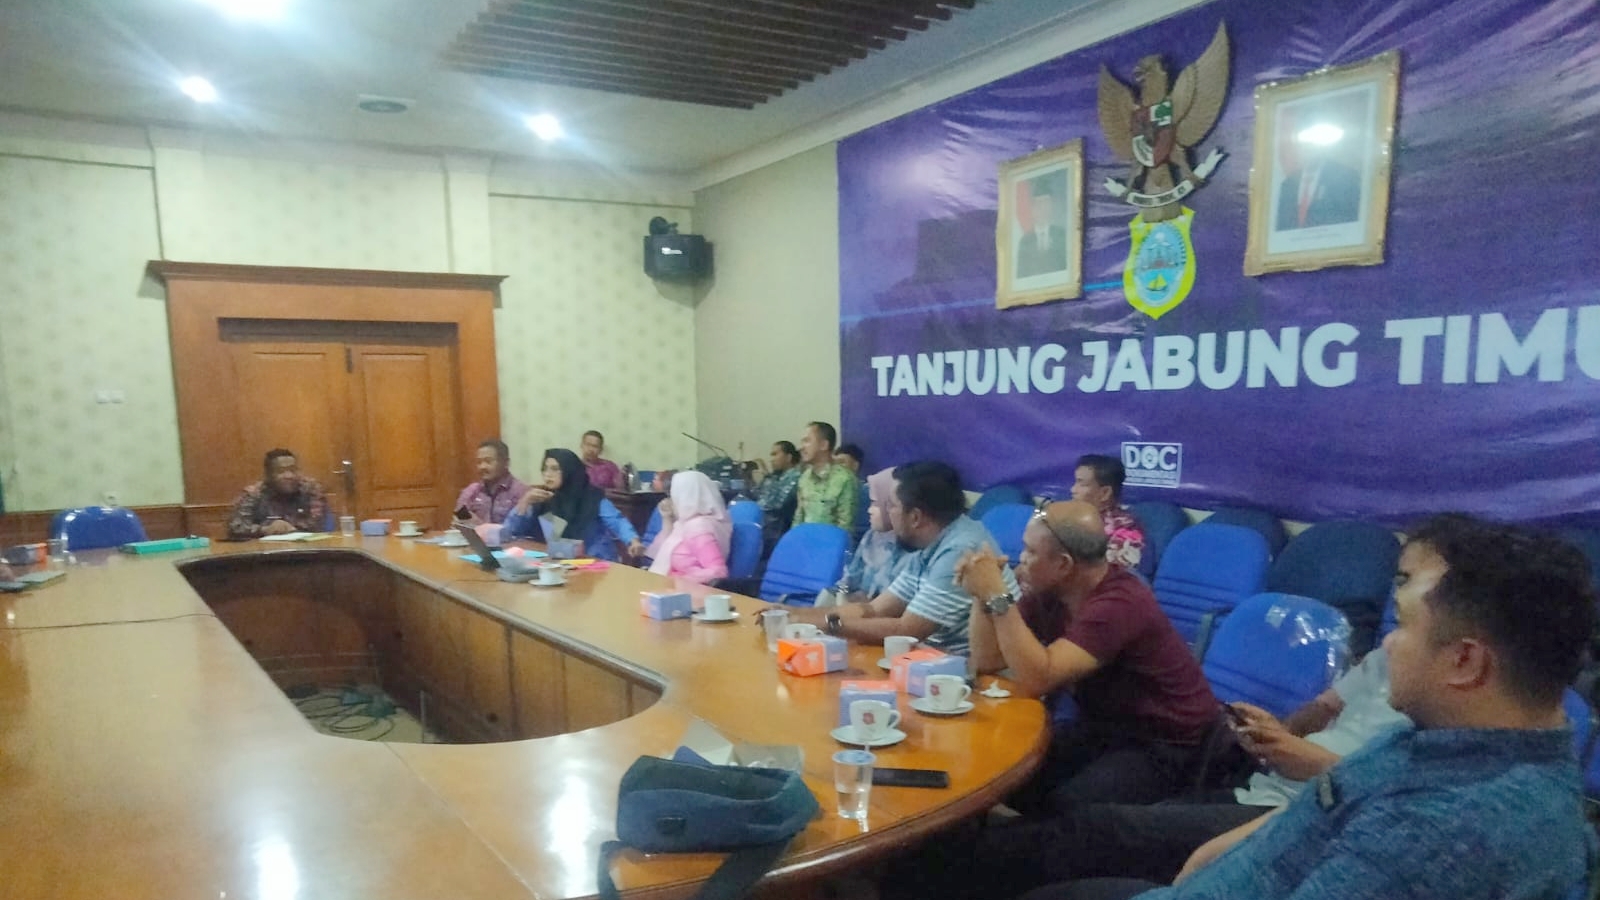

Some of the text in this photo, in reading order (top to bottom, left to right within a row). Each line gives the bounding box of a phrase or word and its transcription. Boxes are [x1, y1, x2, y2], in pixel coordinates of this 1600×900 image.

[871, 343, 1067, 397] TANJUNG
[1076, 322, 1360, 393] JABUNG
[1125, 445, 1177, 471] DOC
